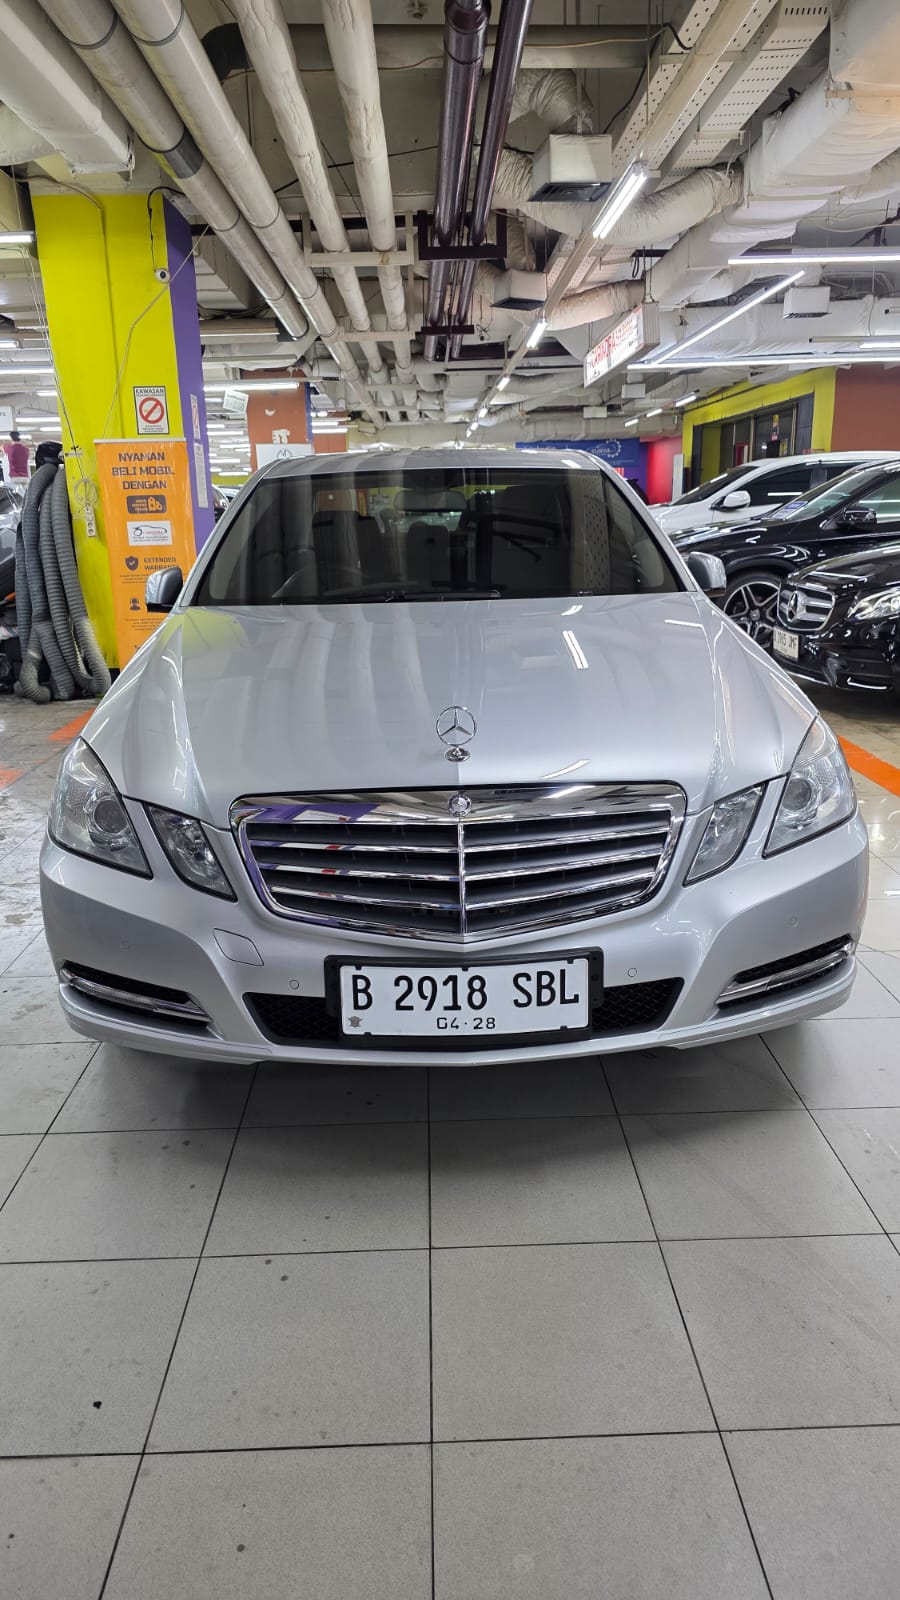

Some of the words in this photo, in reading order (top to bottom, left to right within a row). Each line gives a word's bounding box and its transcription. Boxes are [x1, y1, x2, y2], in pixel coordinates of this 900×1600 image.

[118, 452, 165, 461] NYAMAN
[112, 466, 137, 476] BELI
[139, 465, 175, 475] MOBIL
[122, 480, 167, 490] DENGAN
[352, 974, 373, 1011] B
[394, 974, 488, 1011] 2918
[512, 968, 580, 1008] SBL
